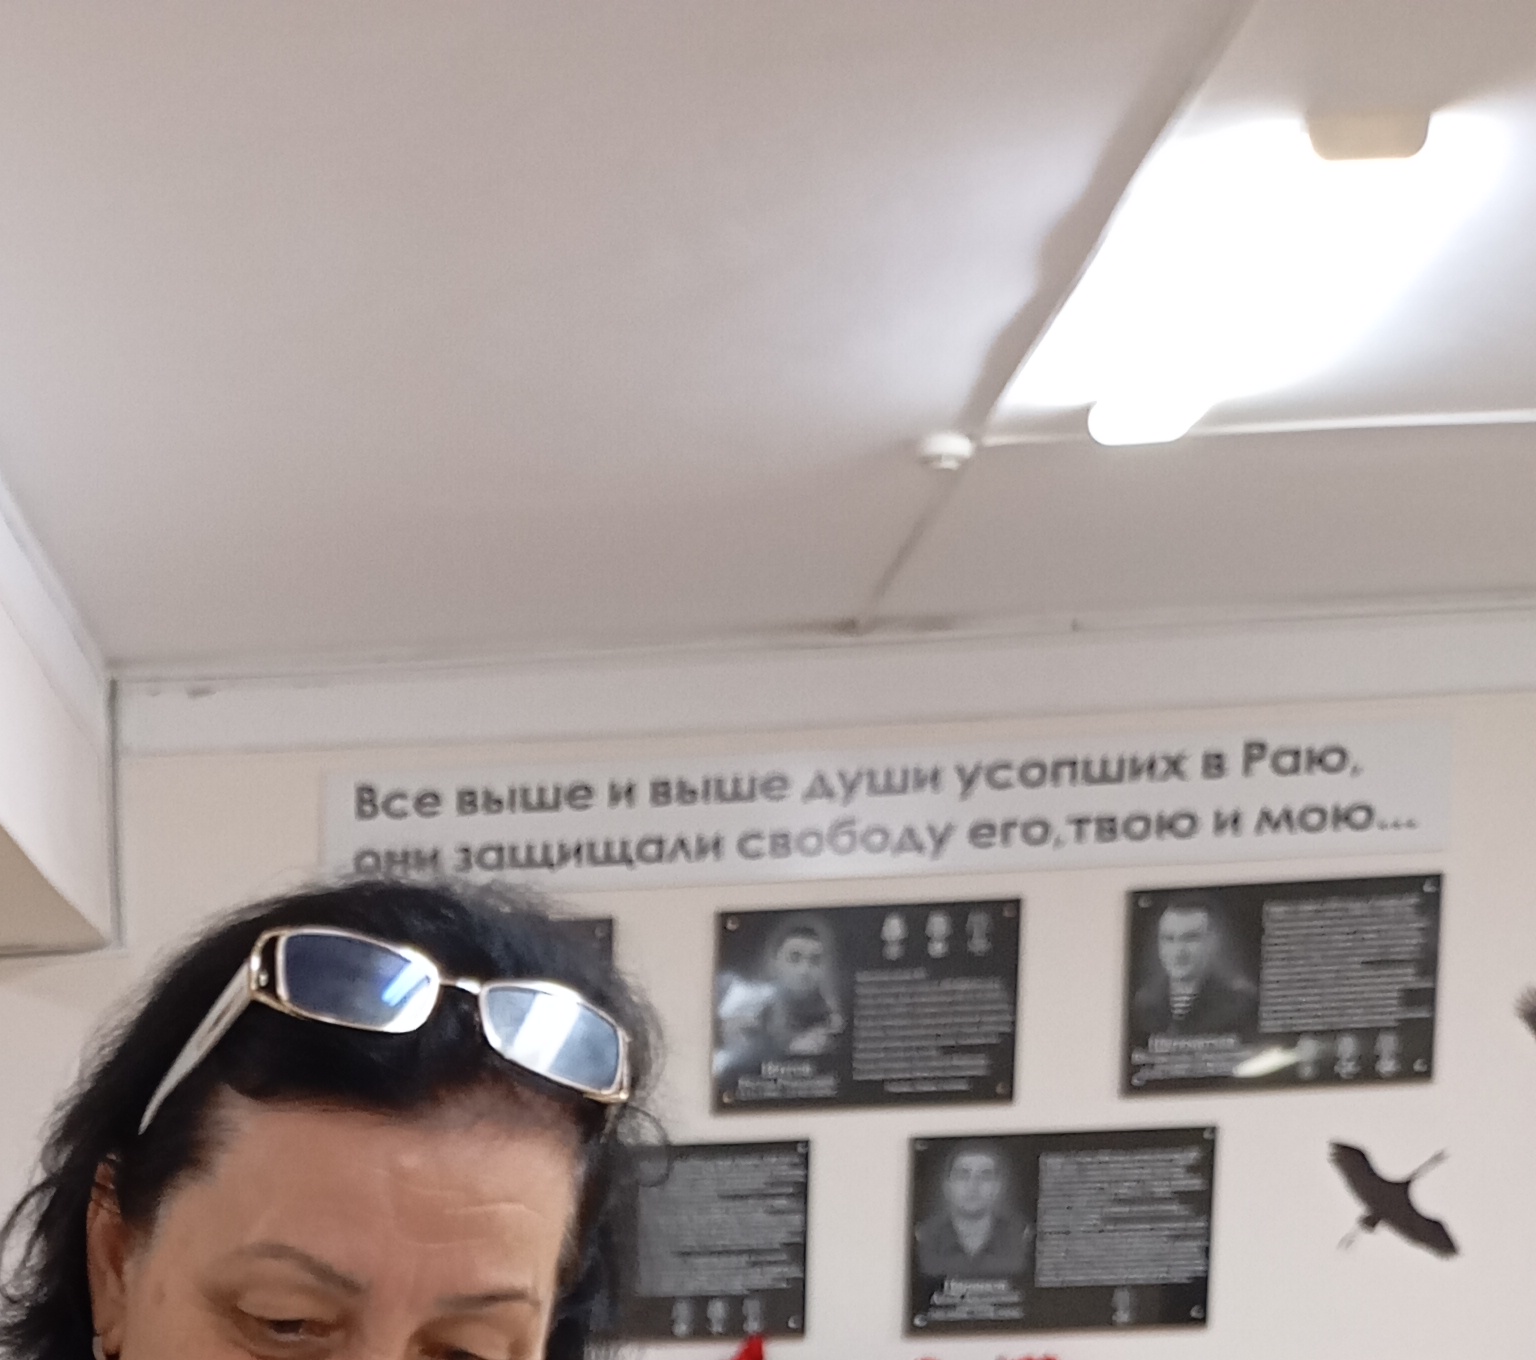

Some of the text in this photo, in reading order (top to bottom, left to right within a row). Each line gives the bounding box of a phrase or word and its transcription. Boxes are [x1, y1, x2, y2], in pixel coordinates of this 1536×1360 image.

[354, 738, 1364, 821] Все выше и выше души усопших в Раю,
[352, 847, 439, 876] они
[453, 832, 725, 874] защищали
[736, 815, 957, 861] свободу
[1212, 806, 1243, 838] и
